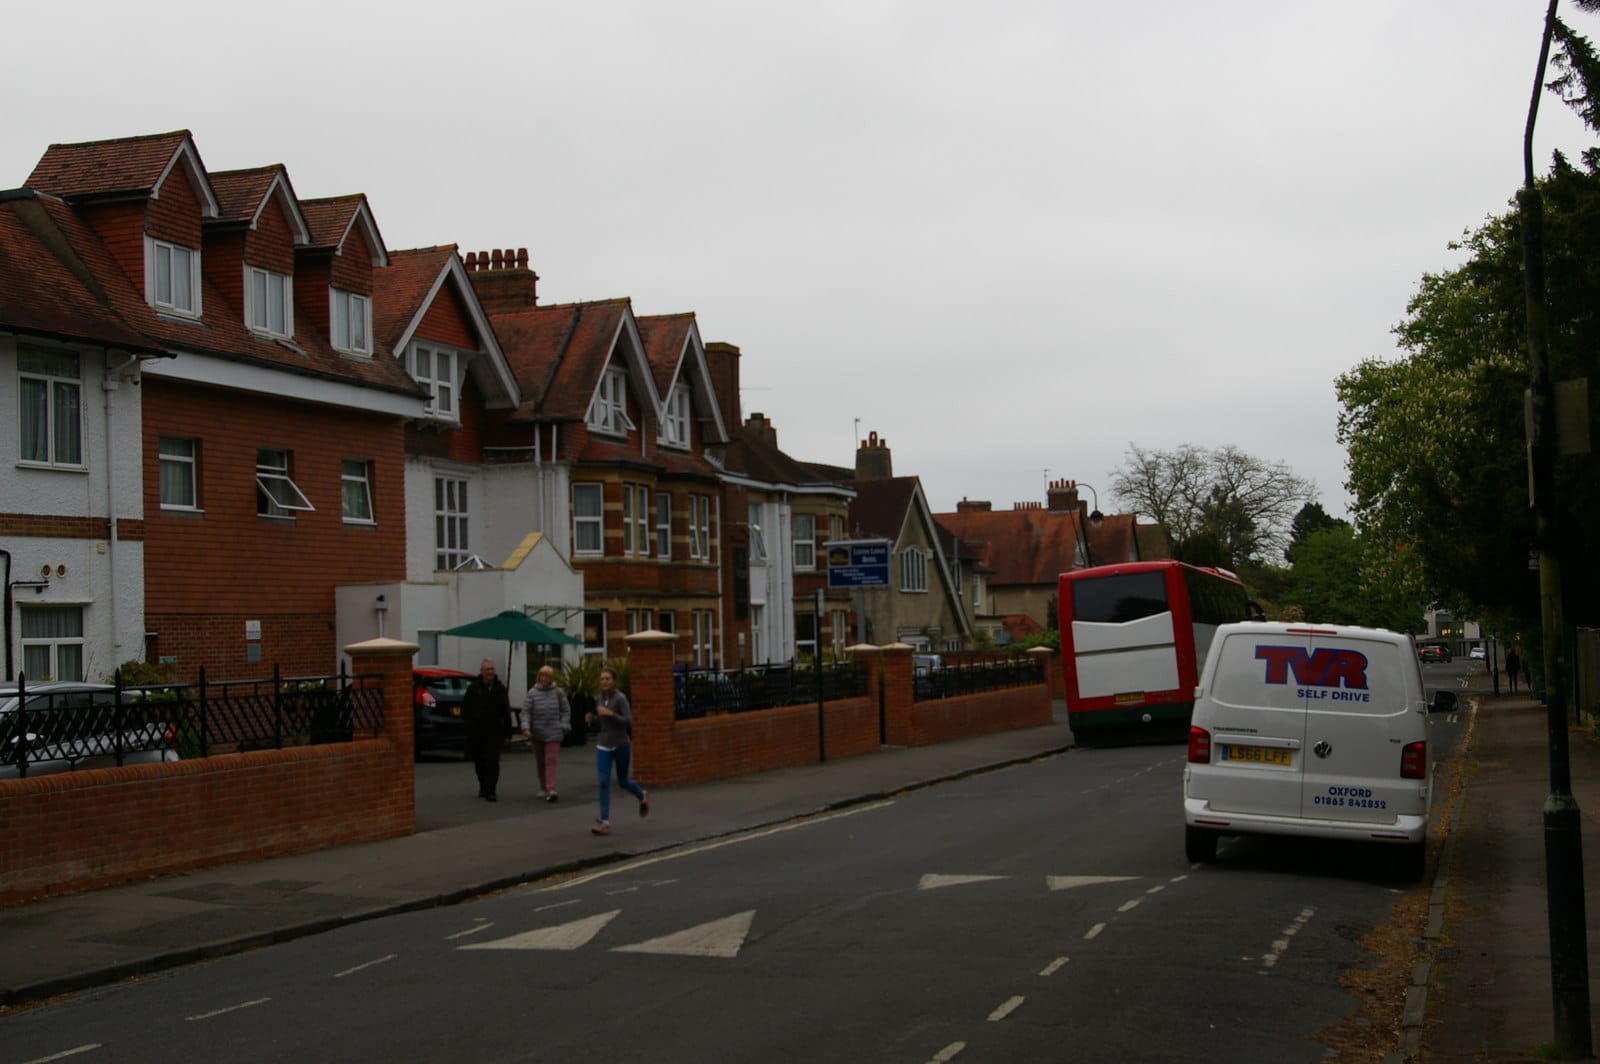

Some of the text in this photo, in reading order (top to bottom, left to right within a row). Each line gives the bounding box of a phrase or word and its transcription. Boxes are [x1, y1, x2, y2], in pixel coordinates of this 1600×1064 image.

[1255, 645, 1369, 689] TVR
[1297, 689, 1370, 702] SELF DRIVE
[1265, 749, 1289, 763] LFF
[1328, 786, 1372, 798] OXFORD
[1314, 796, 1387, 809] 01865 842852
